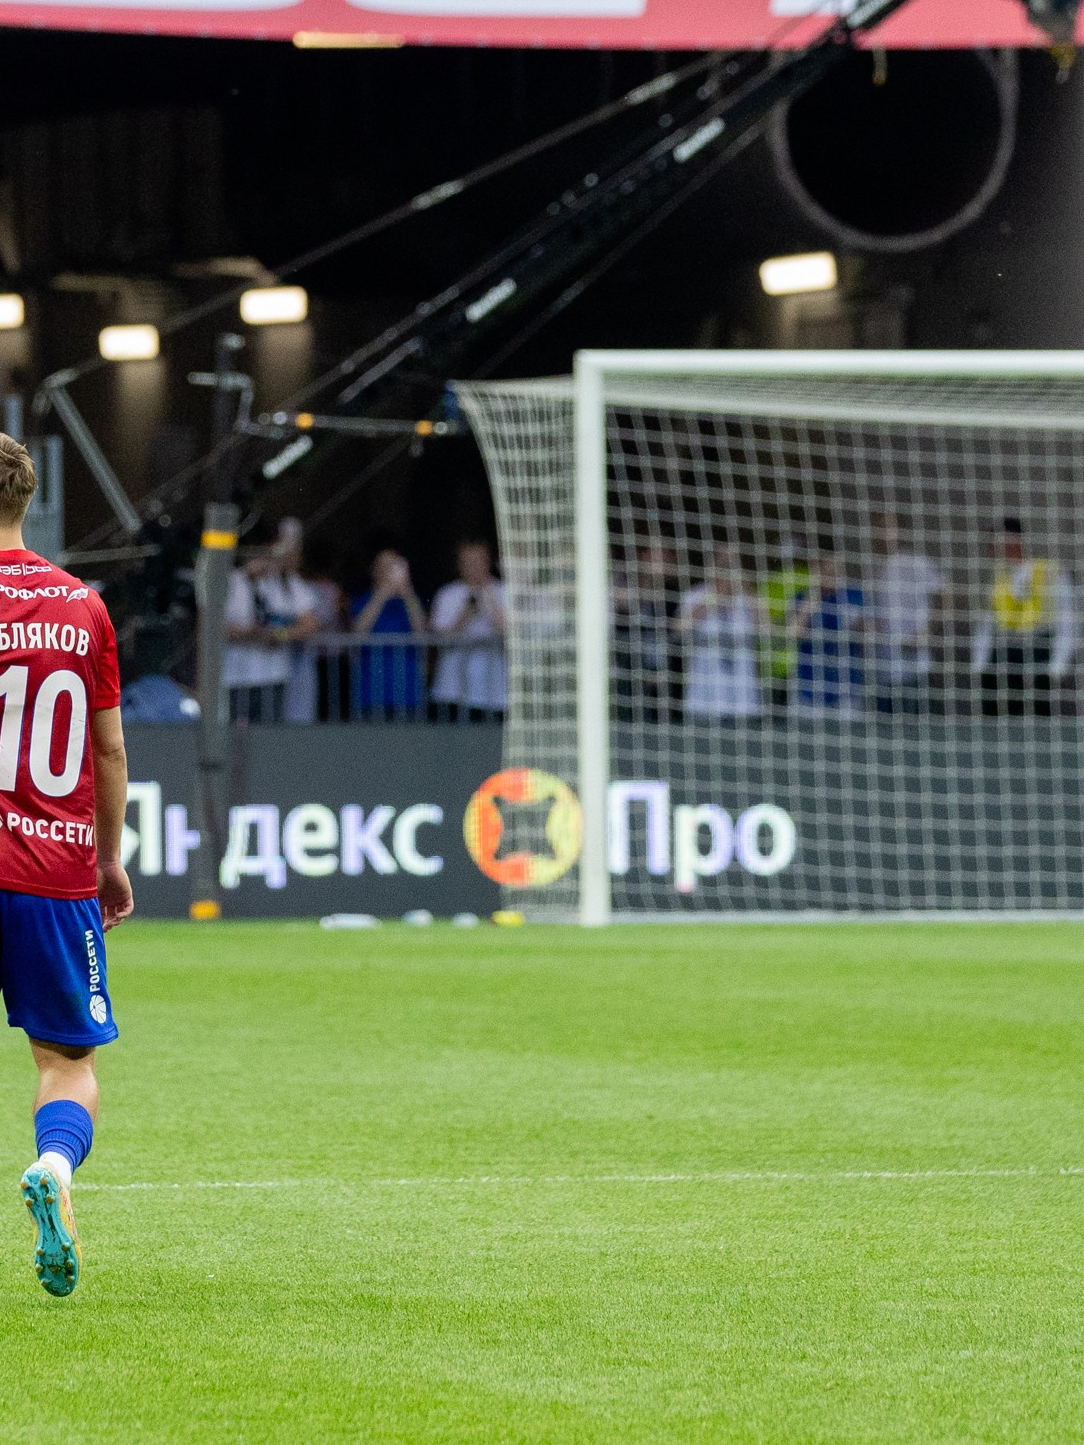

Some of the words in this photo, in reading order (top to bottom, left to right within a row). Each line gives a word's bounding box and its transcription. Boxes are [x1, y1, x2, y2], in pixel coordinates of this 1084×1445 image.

[6, 811, 94, 847] РОССЕТИ
[607, 780, 797, 892] Про
[84, 929, 101, 993] РОССЕТИ
